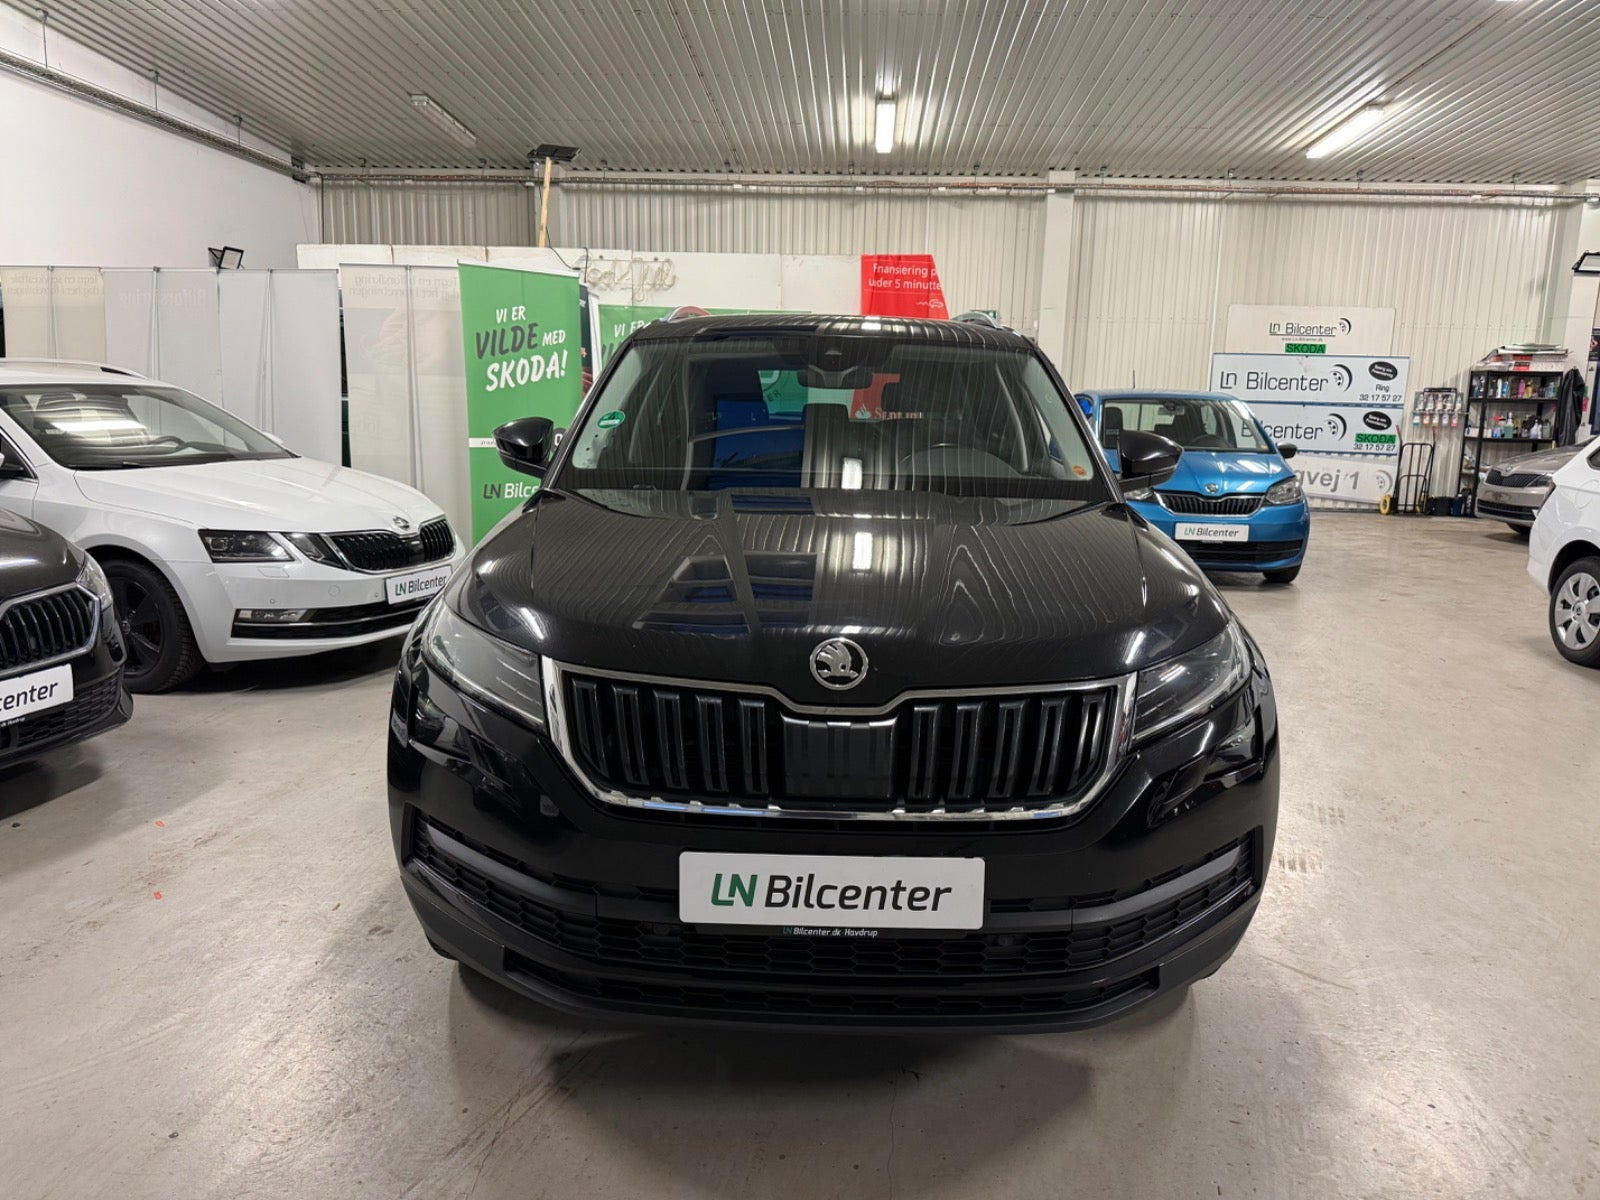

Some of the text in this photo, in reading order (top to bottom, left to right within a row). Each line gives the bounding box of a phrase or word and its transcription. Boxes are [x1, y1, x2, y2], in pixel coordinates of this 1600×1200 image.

[873, 262, 929, 278] Fnansiering
[868, 277, 892, 288] uder
[895, 278, 901, 289] 5
[495, 305, 526, 324] VI ER
[613, 322, 626, 338] VI
[1285, 322, 1337, 336] Bilcenter
[475, 322, 566, 360] VILDE MED
[1286, 344, 1325, 354] SKODA
[485, 349, 568, 392] SKODA!
[1246, 371, 1329, 393] Bilcenter
[1375, 383, 1390, 393] Ring
[1359, 393, 1369, 401] 32
[1371, 394, 1380, 402] 17
[1356, 433, 1396, 444] SKODA
[1349, 471, 1360, 490] 1
[483, 483, 502, 499] LN
[1183, 527, 1239, 537] LN Bilcenter
[395, 576, 446, 596] LN Bilcenter
[0, 682, 59, 712] enter
[710, 873, 953, 912] LN Bilcenter
[793, 927, 841, 936] Bilcenter.dk
[844, 928, 878, 939] Havdrup
